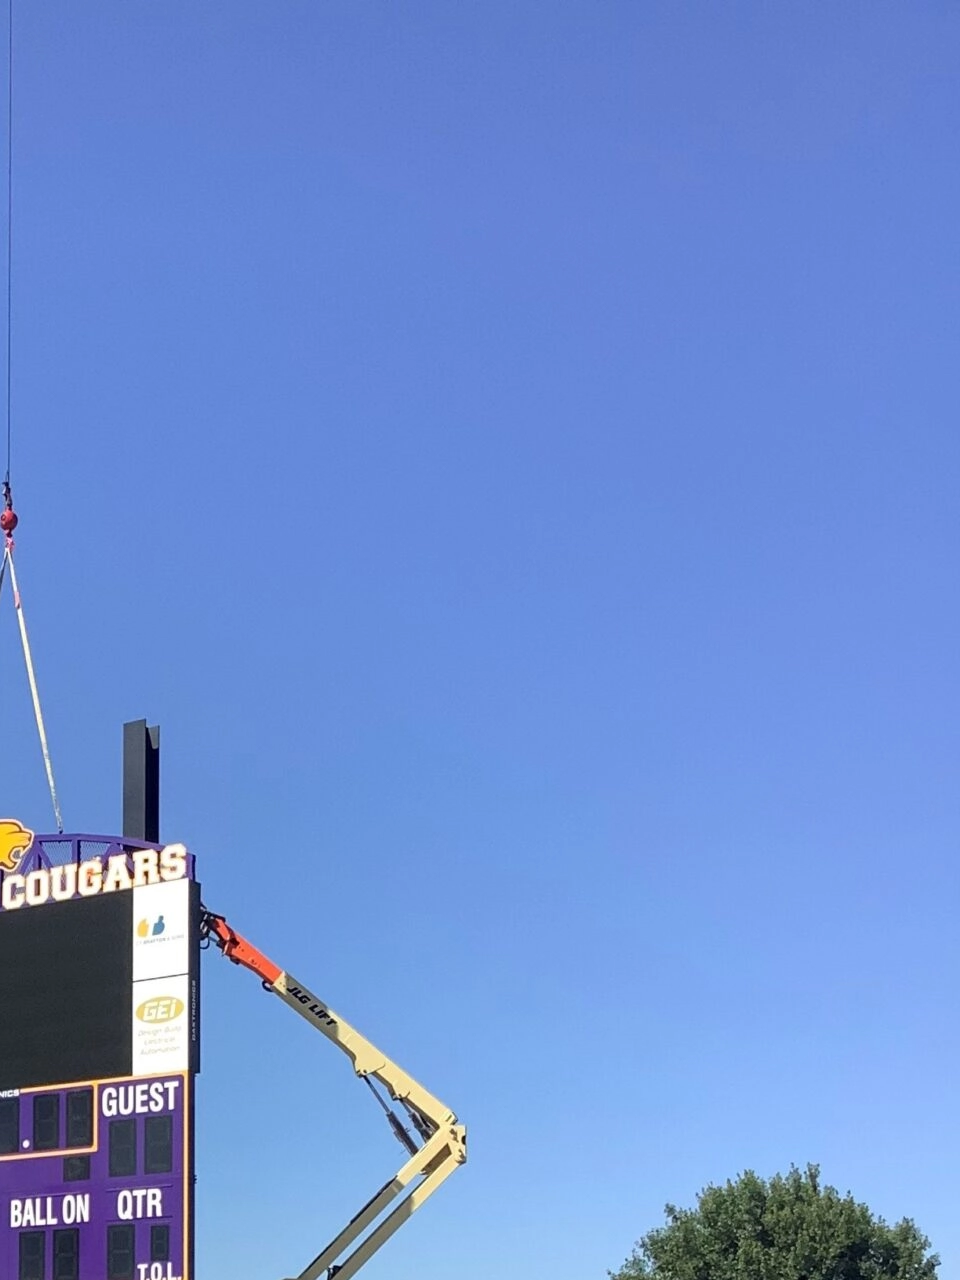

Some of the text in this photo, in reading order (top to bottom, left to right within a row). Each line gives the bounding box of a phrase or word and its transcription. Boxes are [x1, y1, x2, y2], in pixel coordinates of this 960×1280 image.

[2, 843, 187, 911] COUGARS
[286, 986, 338, 1026] JLG LIFT
[101, 1081, 179, 1117] GUEST
[10, 1194, 90, 1228] BALL ON
[117, 1188, 162, 1220] QTR
